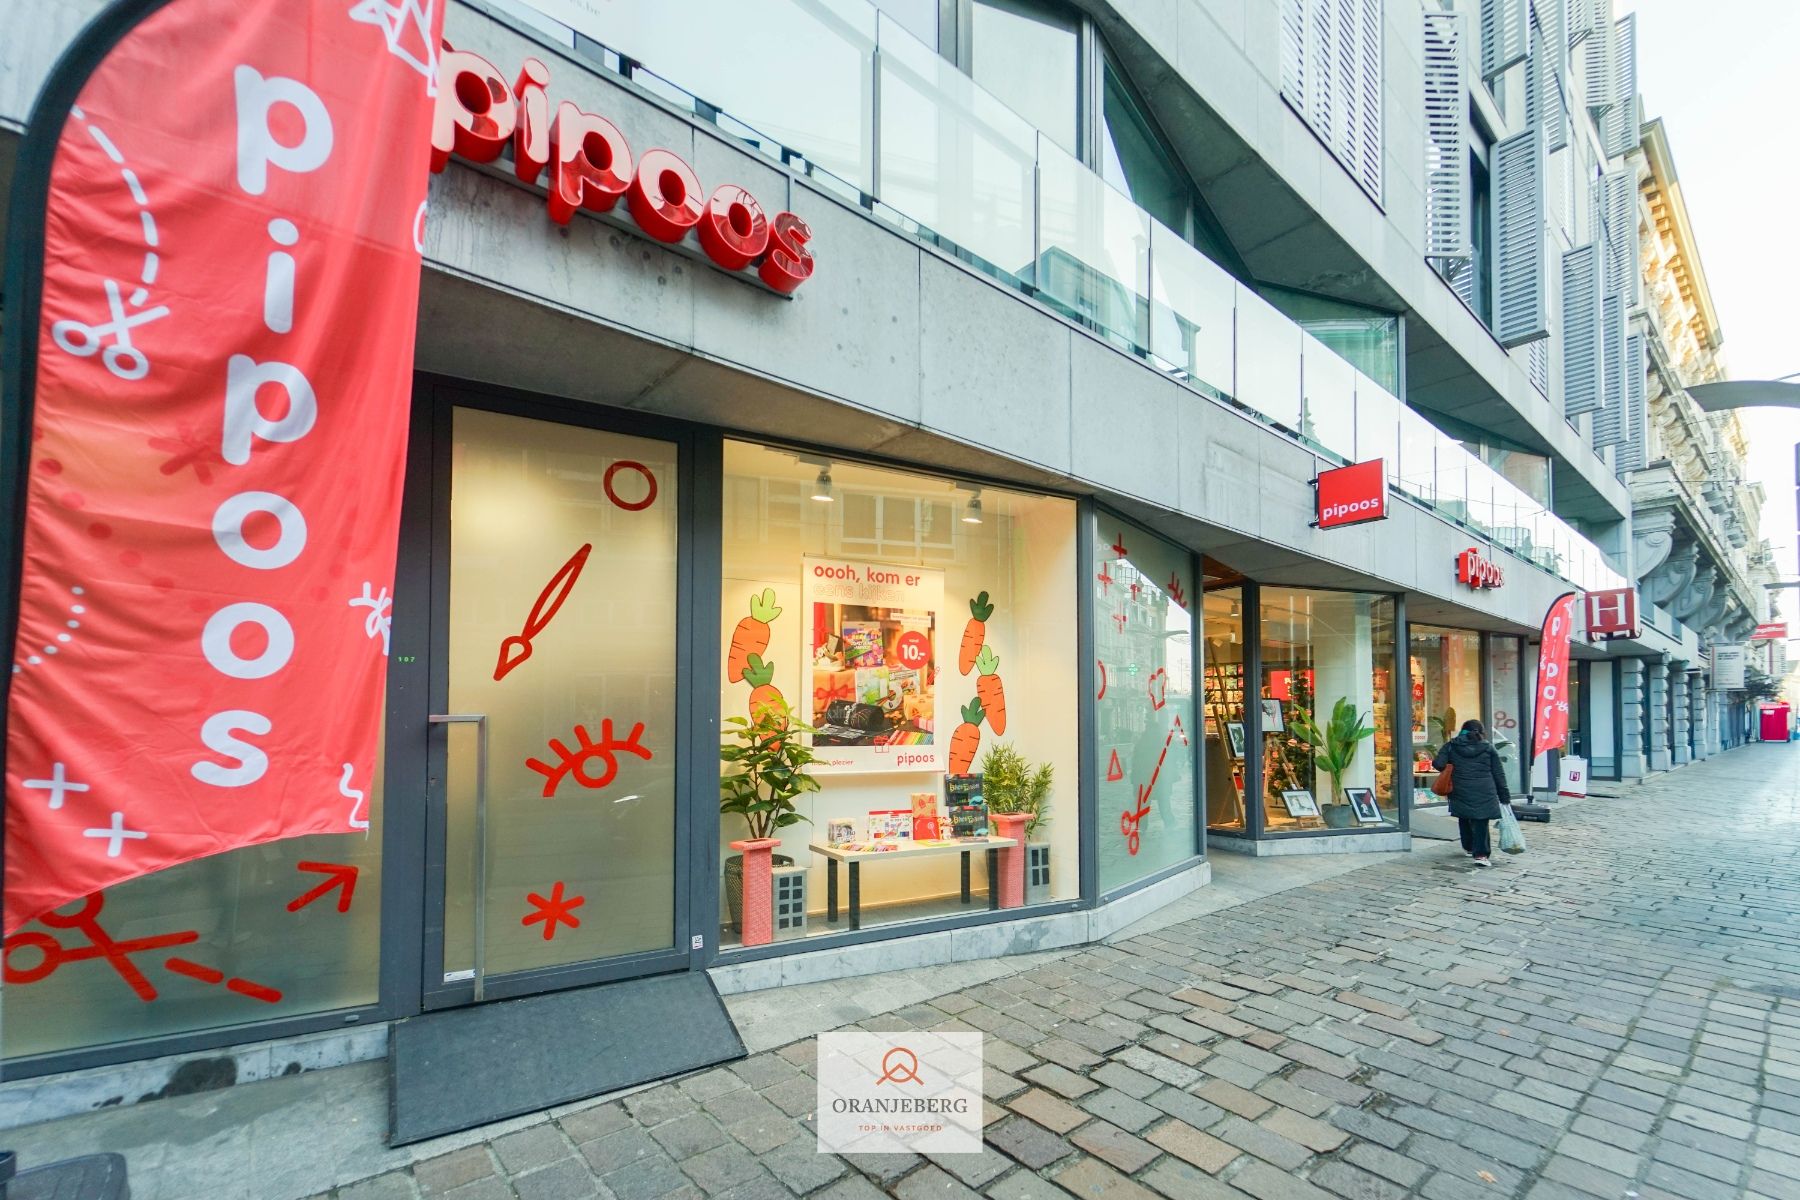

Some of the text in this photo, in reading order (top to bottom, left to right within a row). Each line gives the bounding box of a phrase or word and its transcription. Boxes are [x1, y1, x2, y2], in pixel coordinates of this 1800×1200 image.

[432, 48, 814, 290] pipoos
[191, 64, 334, 787] pipoos
[1323, 498, 1379, 520] pipoos
[814, 565, 921, 587] oooh, kom er
[1461, 548, 1504, 588] pipoos
[814, 583, 905, 603] eens kijken
[1590, 593, 1628, 627] H
[902, 644, 926, 661] 10.-
[897, 752, 935, 767] pipoos
